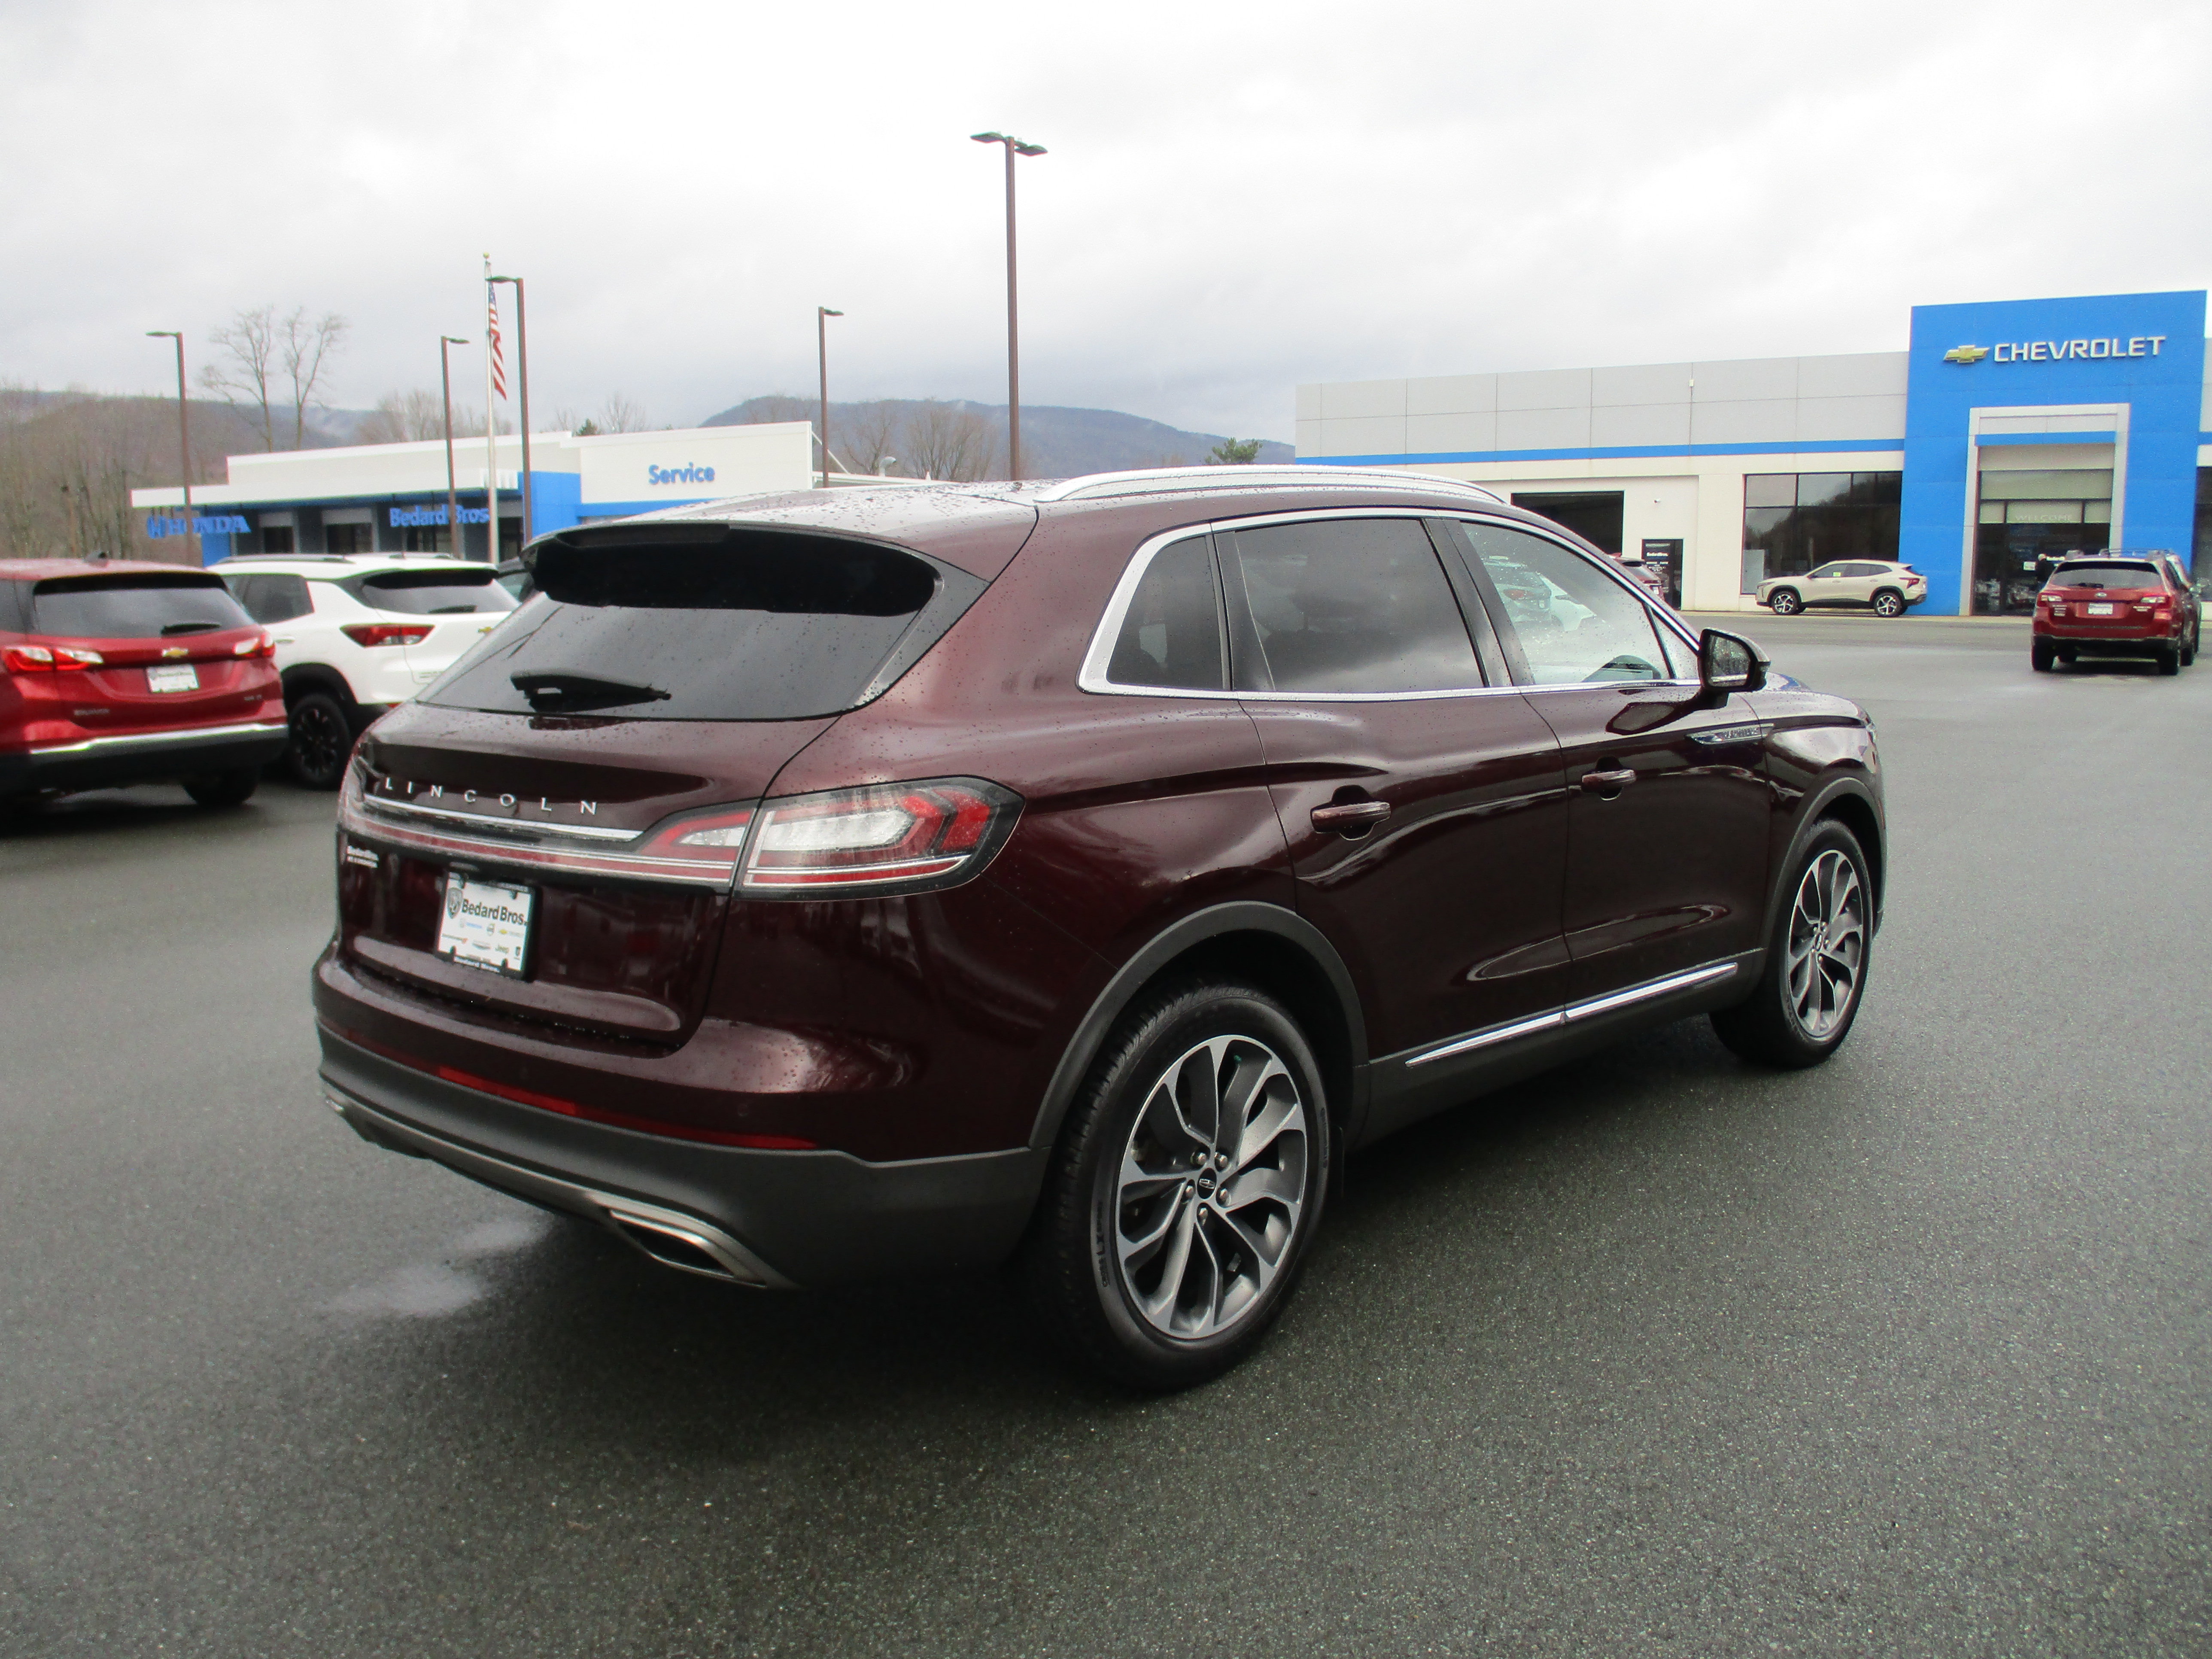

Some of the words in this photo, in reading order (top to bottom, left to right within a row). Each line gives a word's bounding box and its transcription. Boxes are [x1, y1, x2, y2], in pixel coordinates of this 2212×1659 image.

[1994, 335, 2166, 362] CHEVROLET
[648, 461, 715, 485] Service
[390, 504, 450, 527] Bedard
[385, 777, 597, 816] LINCOLN
[461, 898, 500, 920] Bedard
[499, 906, 529, 927] Bros.
